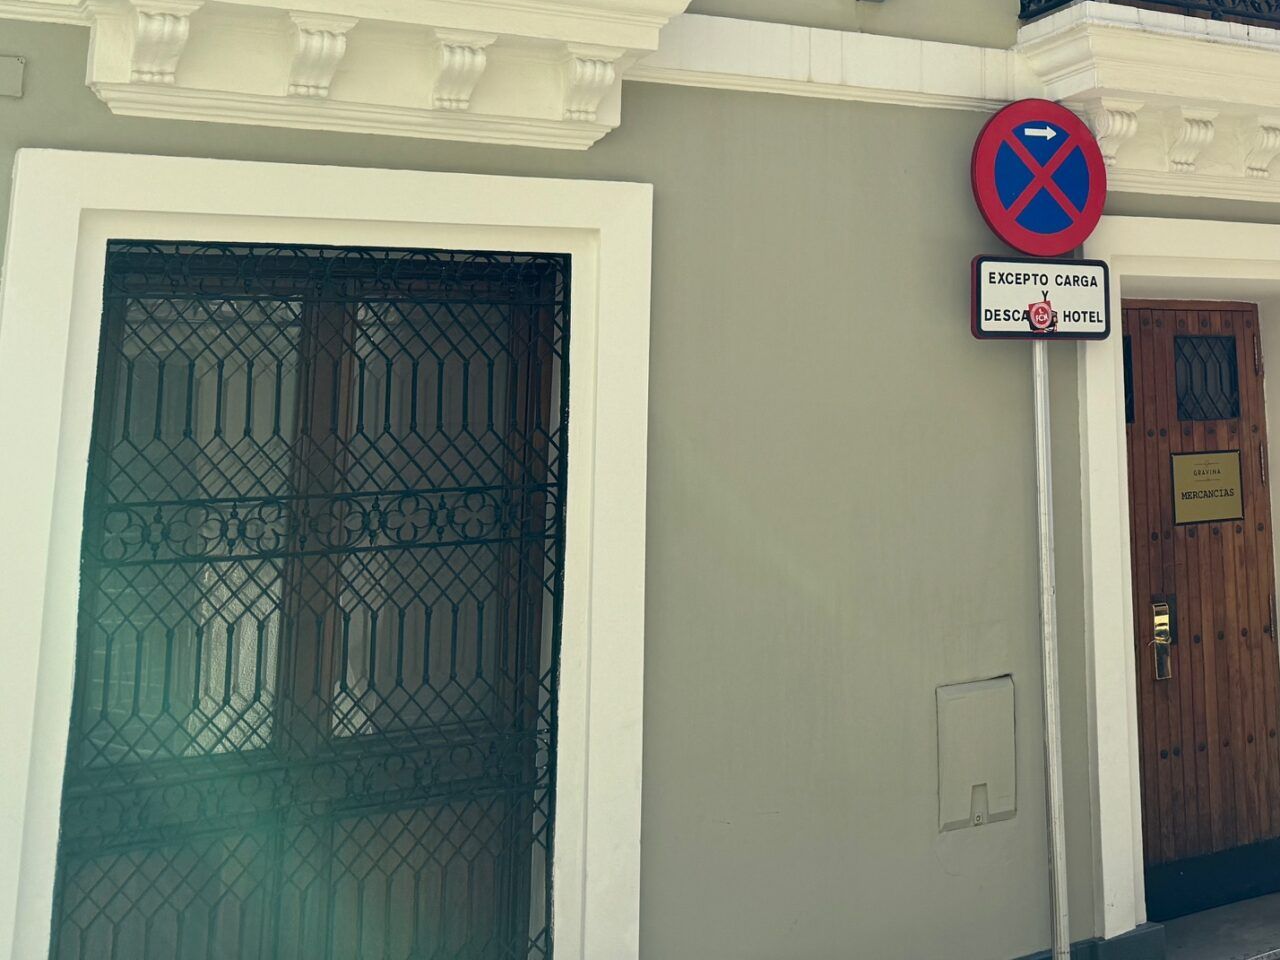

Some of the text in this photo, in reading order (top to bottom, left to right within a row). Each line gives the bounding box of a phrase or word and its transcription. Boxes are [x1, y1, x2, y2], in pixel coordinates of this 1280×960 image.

[988, 271, 1098, 287] EXCEPTO CARGA
[1041, 290, 1049, 302] Y
[984, 308, 1103, 323] DESCA HOTEL
[1181, 488, 1235, 500] MERCANCIAS
